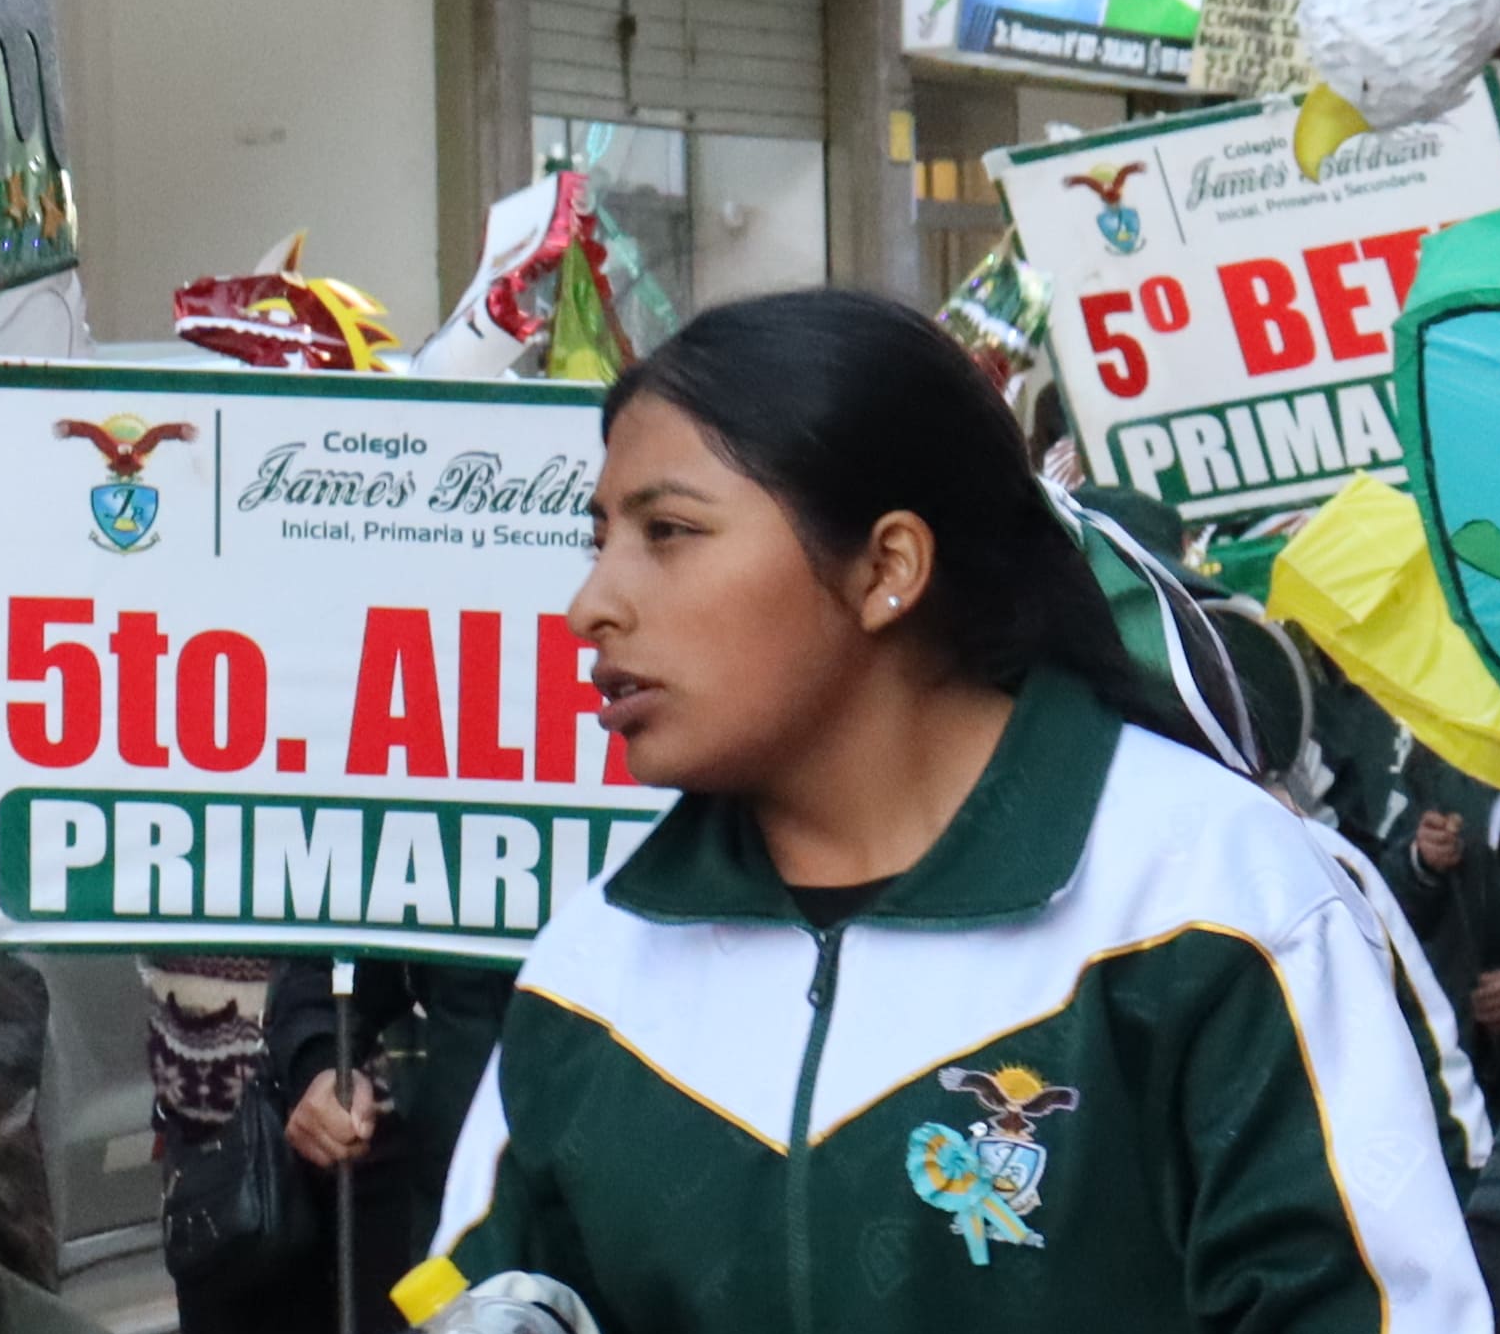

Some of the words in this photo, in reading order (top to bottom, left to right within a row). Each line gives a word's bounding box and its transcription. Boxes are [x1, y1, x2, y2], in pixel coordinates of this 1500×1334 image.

[1185, 156, 1291, 211] James
[1300, 126, 1445, 185] aldwin
[1222, 134, 1289, 160] Colegio
[1216, 197, 1263, 224] Inicial,
[1265, 184, 1329, 217] Primaria
[1344, 169, 1428, 199] Secundaria
[1217, 221, 1464, 378] BET
[237, 442, 416, 513] James
[322, 430, 428, 458] Colegio
[1119, 380, 1404, 502] PRIMA
[281, 518, 357, 545] Inicial,
[362, 520, 464, 546] Primaria
[471, 526, 486, 551] y
[492, 524, 599, 550] Secunda
[4, 595, 308, 774] 5to.
[344, 606, 642, 788] ALF
[28, 797, 647, 931] PRIMARI
